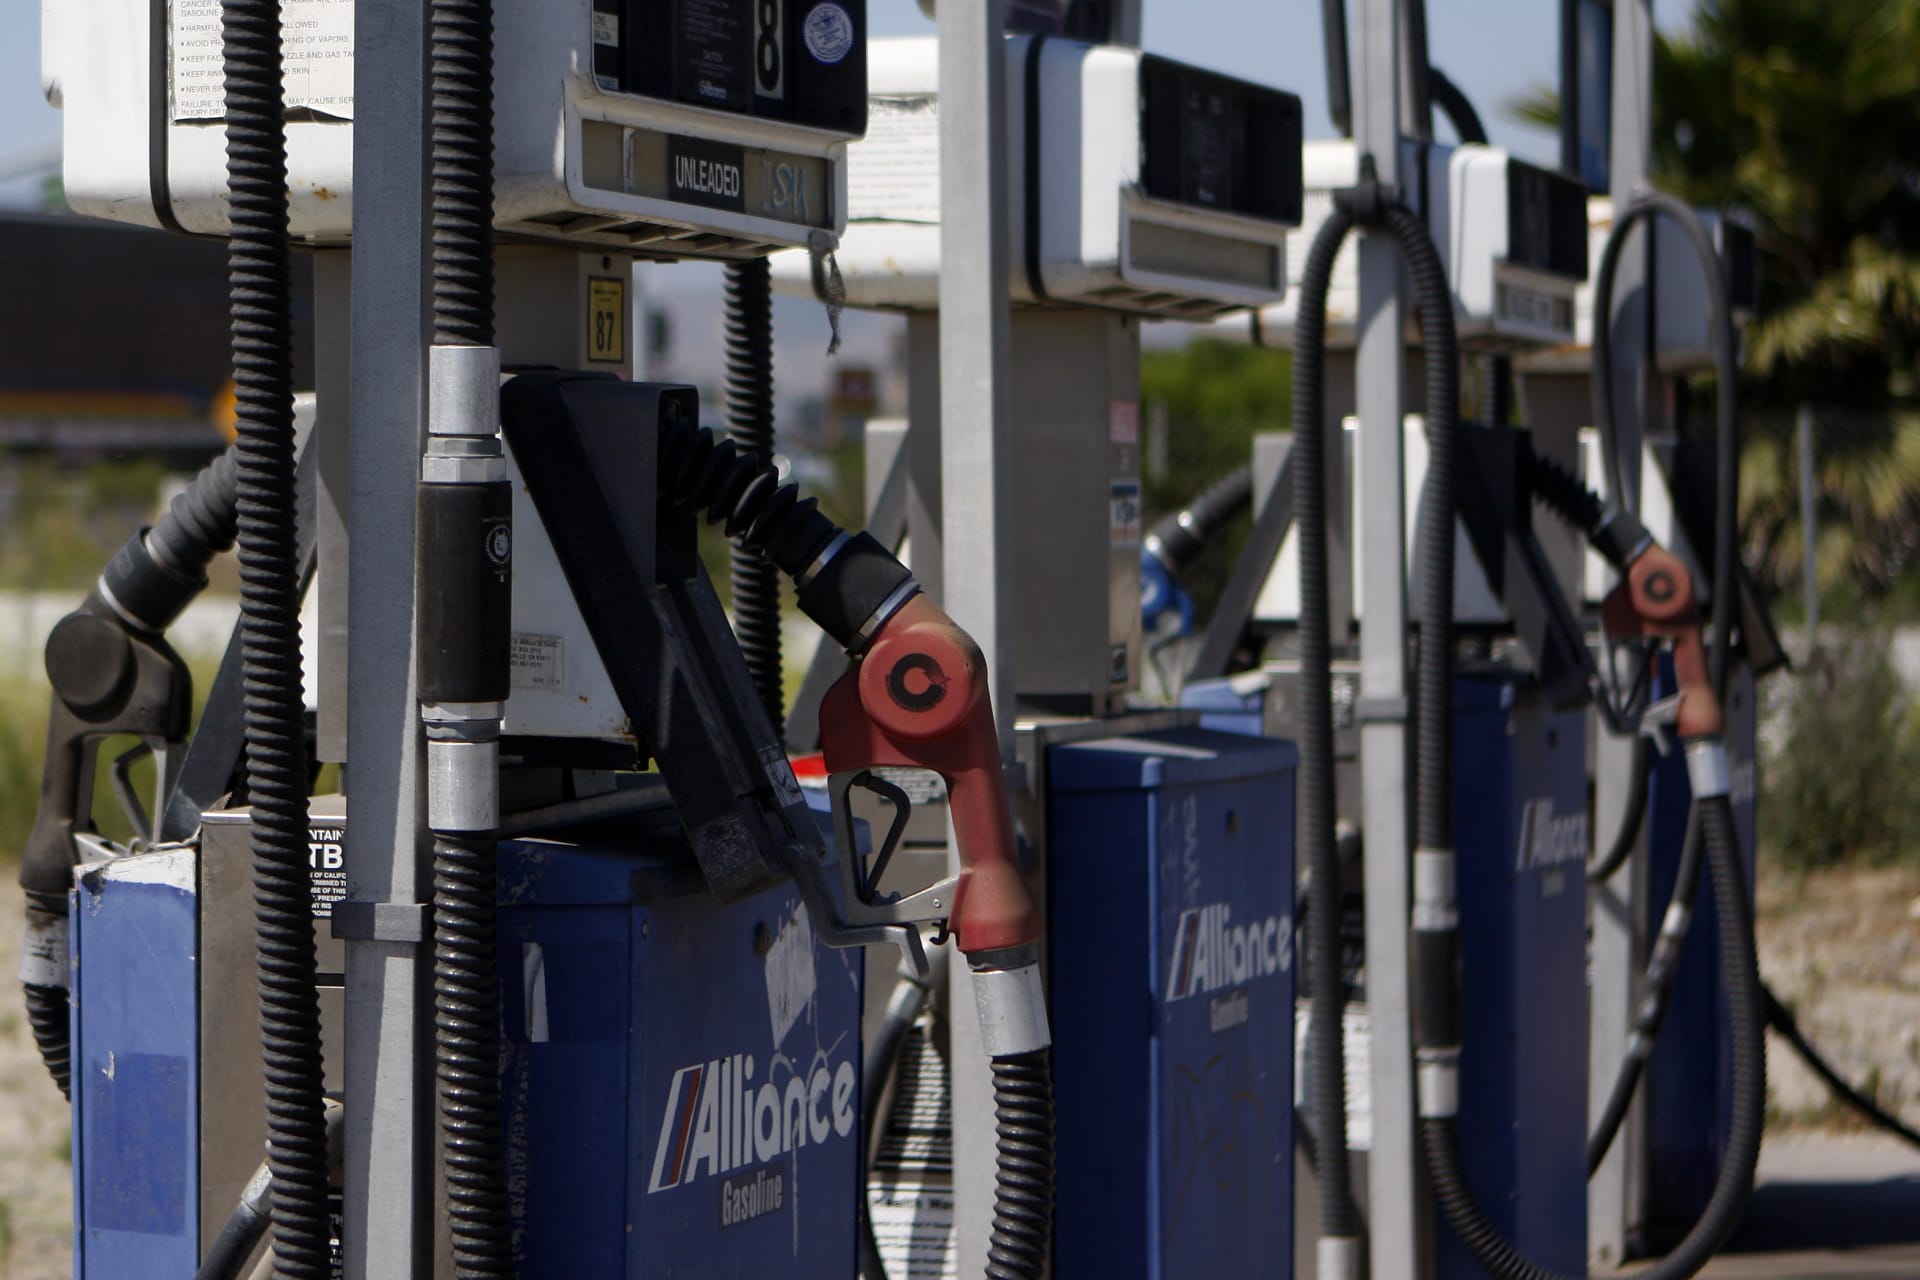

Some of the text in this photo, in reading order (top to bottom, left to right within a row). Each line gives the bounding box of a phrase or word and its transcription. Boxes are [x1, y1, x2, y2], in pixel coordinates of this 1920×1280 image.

[181, 9, 219, 18] GASOLINE
[283, 21, 319, 29] ALLOWED
[186, 40, 209, 48] AVOID
[306, 36, 317, 44] OF
[318, 35, 349, 43] VAPORS
[757, 0, 780, 92] 8
[186, 55, 205, 63] KEEP
[306, 51, 324, 59] AND
[325, 51, 341, 59] GAS
[186, 70, 205, 78] KEEP
[291, 67, 310, 75] SKIN
[186, 86, 210, 94] NEVER
[181, 100, 212, 109] FAILURE
[288, 98, 305, 106] MAY
[308, 96, 336, 105] CAUSE
[181, 109, 207, 117] INJURY
[675, 155, 740, 198] UNLEADED
[596, 310, 615, 352] 87
[308, 829, 344, 841] NTAIN
[308, 843, 343, 869] TB
[1188, 903, 1292, 999] Alliance
[685, 1054, 855, 1184] Alliance
[722, 1169, 783, 1227] Gasoline
